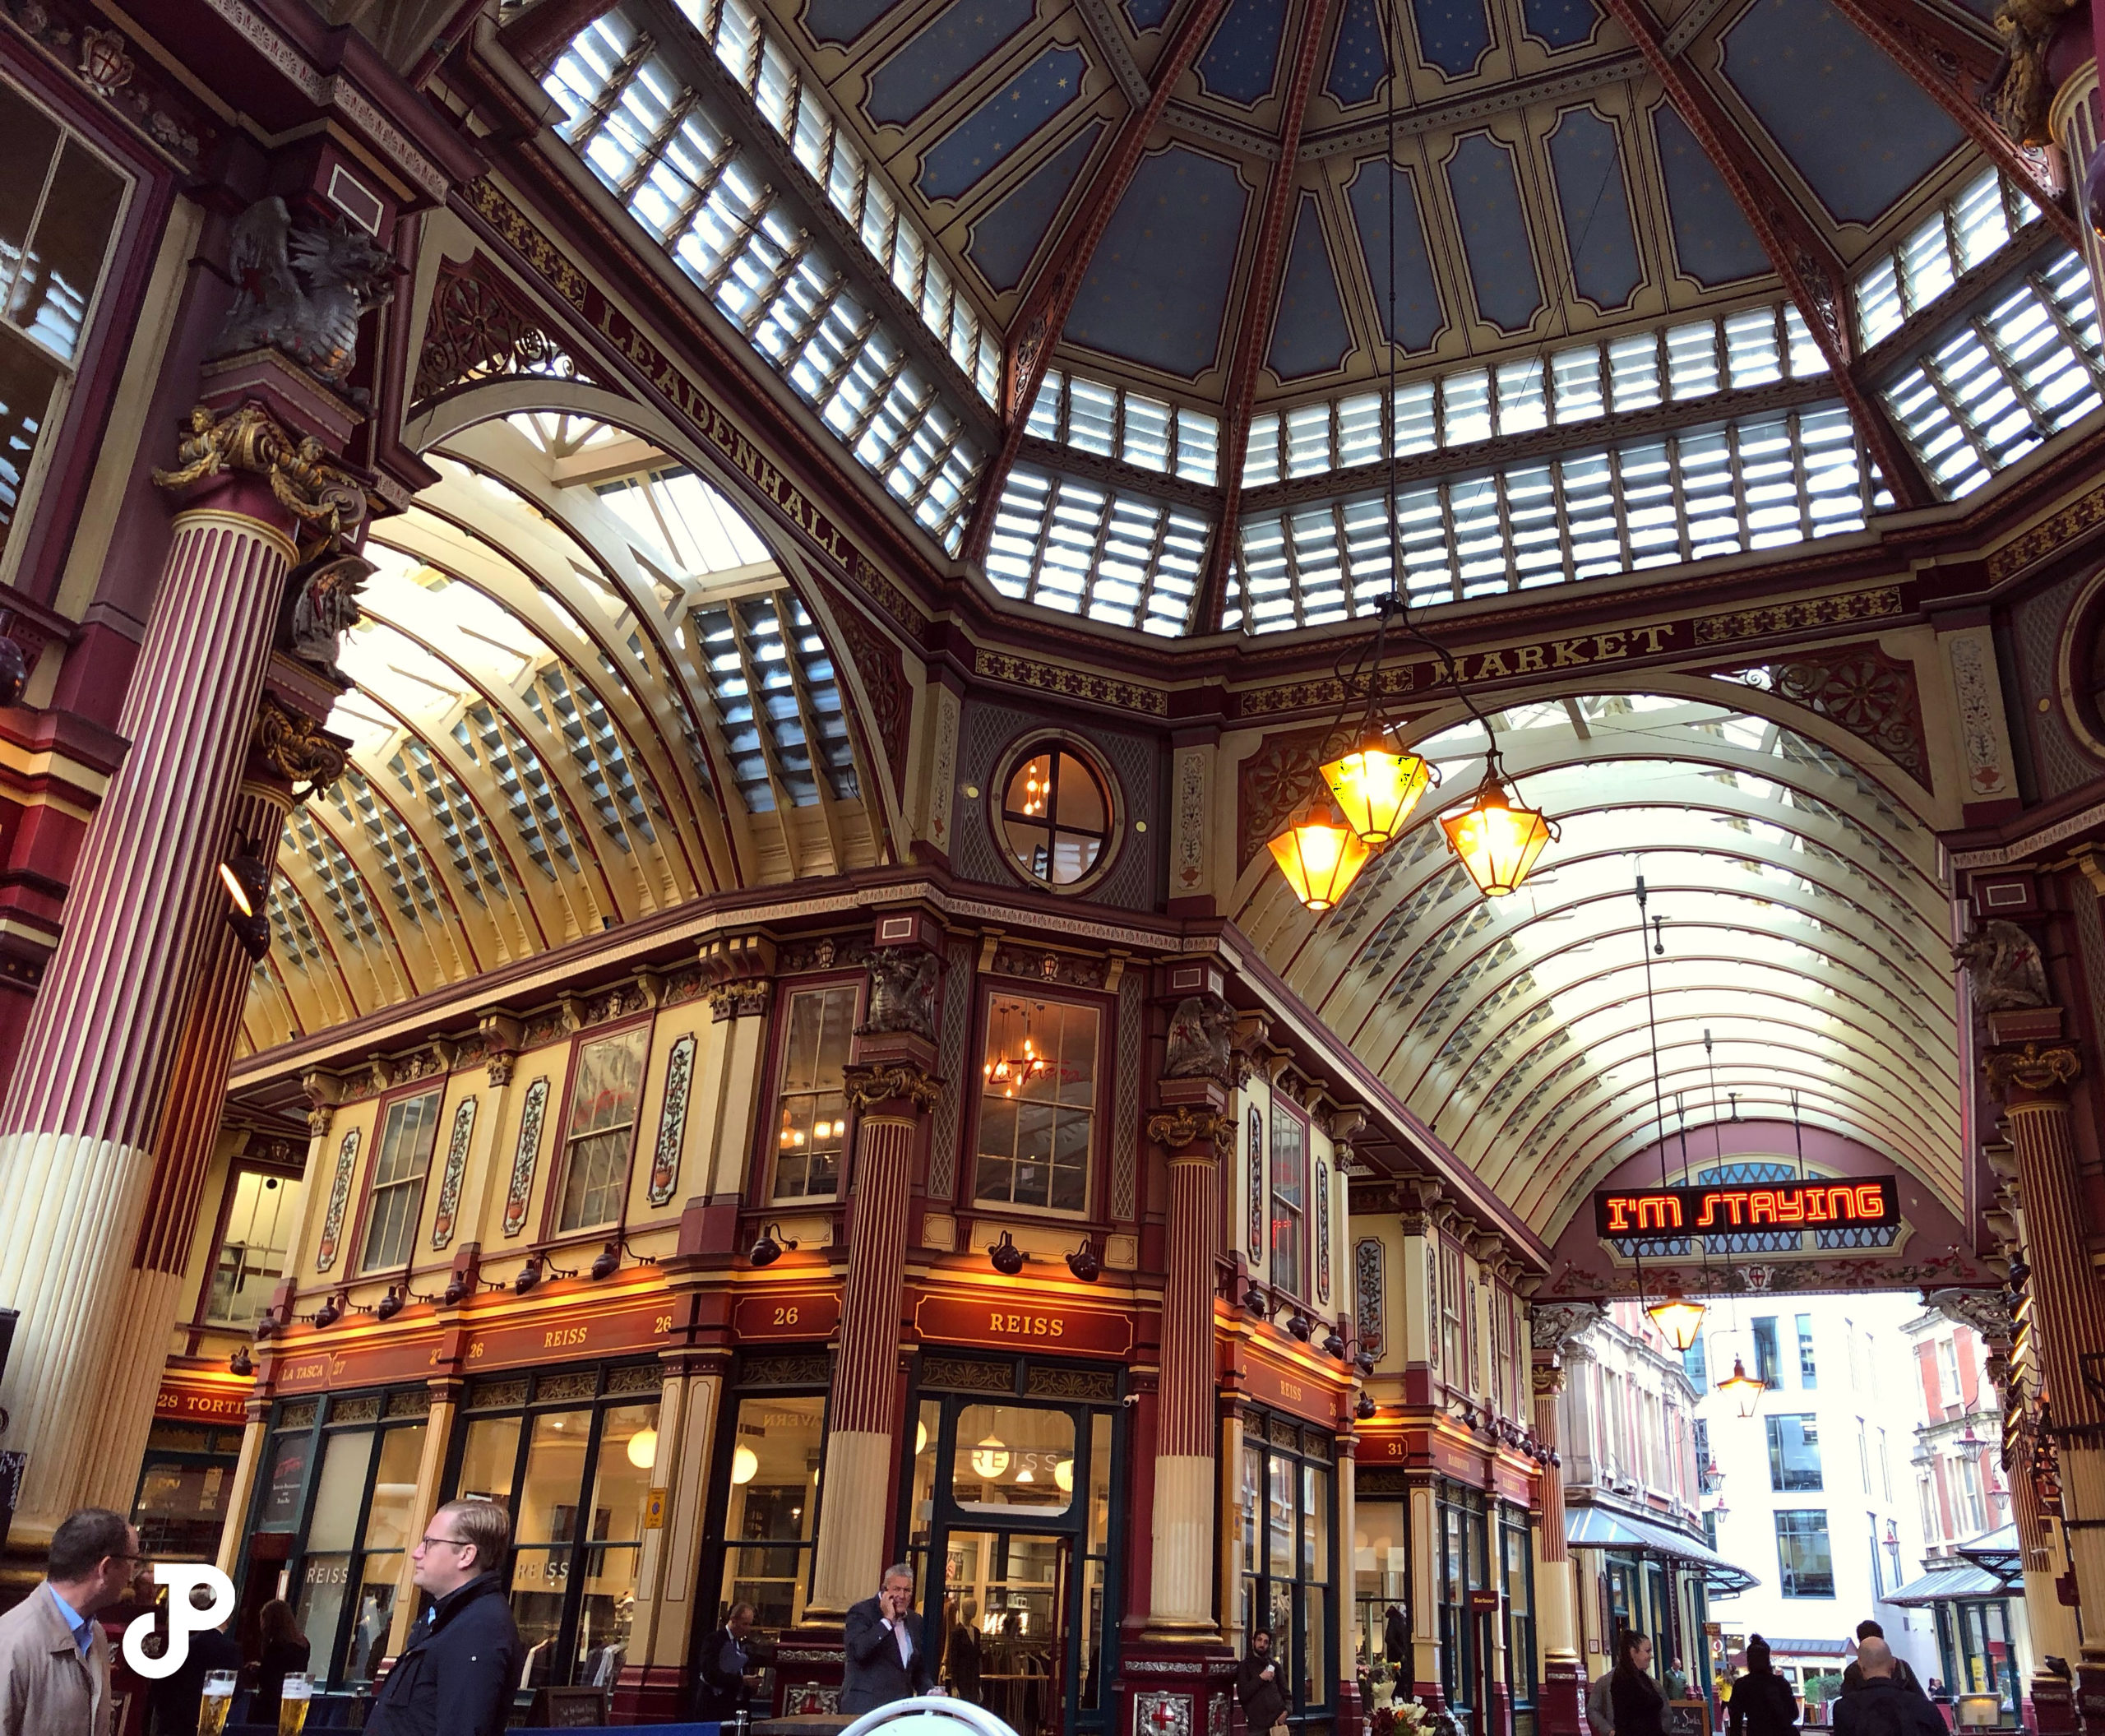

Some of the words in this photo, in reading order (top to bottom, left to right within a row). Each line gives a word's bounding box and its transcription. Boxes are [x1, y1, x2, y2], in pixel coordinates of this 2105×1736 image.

[597, 300, 847, 569] LEADENHALL
[1431, 624, 1674, 686] MARKET
[1608, 1197, 1682, 1229] I'M
[1697, 1184, 1884, 1225] STAYING
[654, 1316, 672, 1334] 26
[773, 1307, 798, 1325] 26
[990, 1313, 1064, 1336] REISS
[544, 1327, 587, 1348] REISS
[469, 1342, 483, 1358] 26
[282, 1368, 294, 1382] LA
[297, 1364, 323, 1379] TASCA
[332, 1360, 346, 1375] 27
[1280, 1381, 1302, 1401] REISS
[157, 1394, 178, 1408] 28
[1388, 1443, 1402, 1455] 31
[972, 1451, 1057, 1472] REISS
[307, 1567, 349, 1583] REISS
[519, 1562, 569, 1579] REISS
